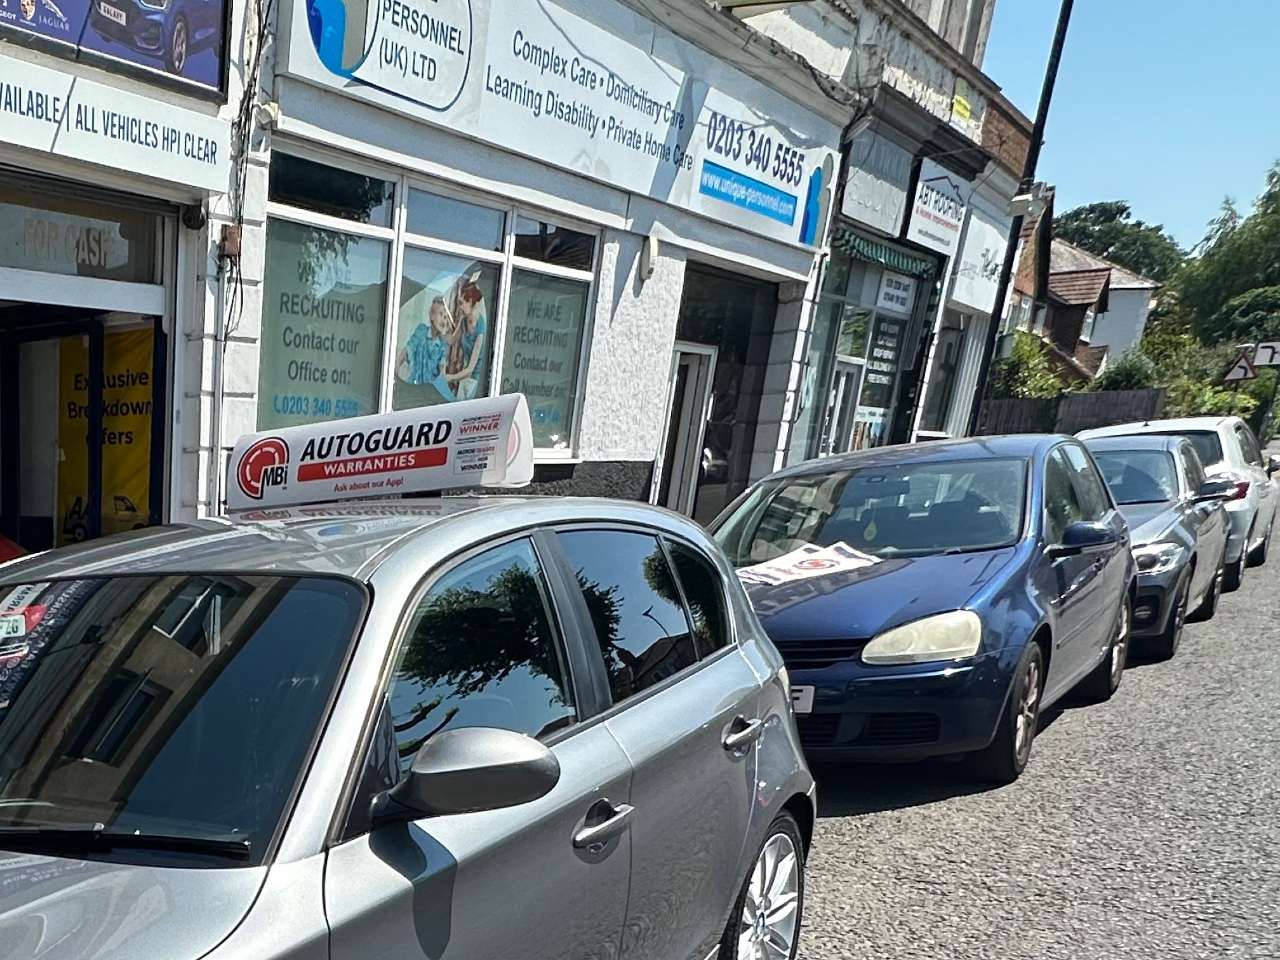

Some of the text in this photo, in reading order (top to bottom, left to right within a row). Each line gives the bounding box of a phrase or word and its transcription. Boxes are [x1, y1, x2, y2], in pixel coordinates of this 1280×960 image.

[38, 14, 70, 32] JAGUAR
[382, 0, 465, 55] PERSONNEL
[380, 37, 437, 82] (UK) LTD
[512, 29, 685, 130] Complex Care Domiciliary Care
[486, 64, 693, 170] Learning Disability Private Home Care
[75, 103, 218, 166] ALL VEHICLES HPI CLEAR
[707, 112, 805, 187] 0203 340 5555
[280, 292, 365, 324] RECRUITING
[282, 326, 361, 355] Contact our
[513, 326, 569, 349] RECRUITING
[287, 359, 328, 383] Office
[513, 352, 549, 372] Contact
[74, 369, 149, 391] Exusive
[67, 397, 152, 419] Brkdown
[300, 419, 453, 462] AUTOGUARD
[459, 422, 499, 434] WINNER
[323, 454, 416, 476] WARRANTIES
[334, 477, 404, 492] Ask about our App!
